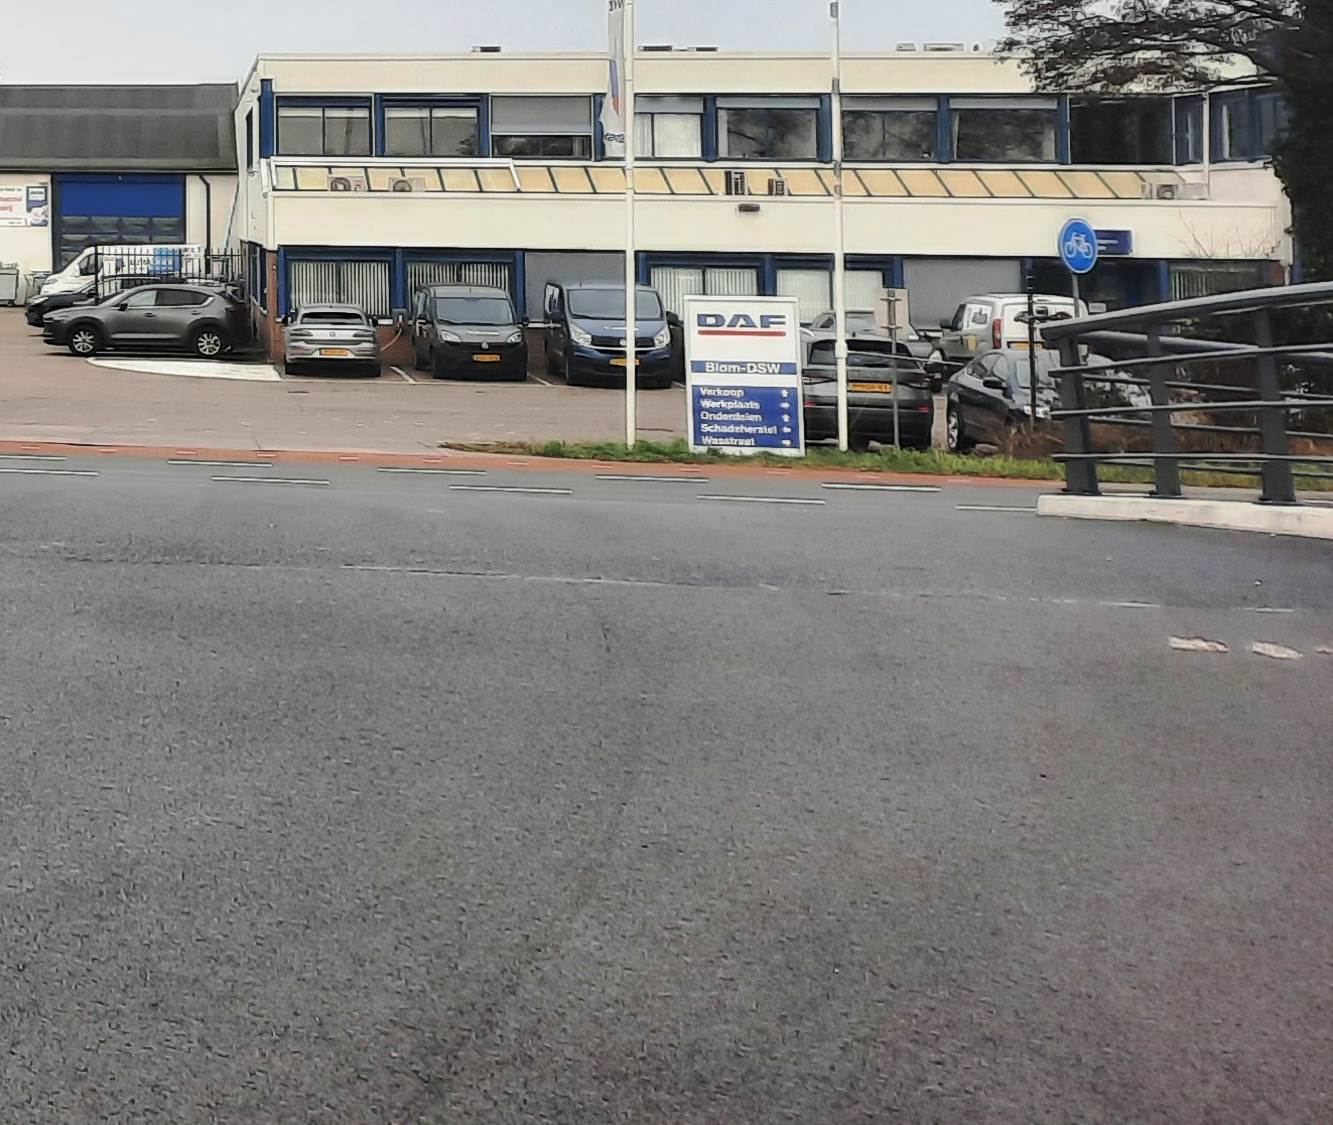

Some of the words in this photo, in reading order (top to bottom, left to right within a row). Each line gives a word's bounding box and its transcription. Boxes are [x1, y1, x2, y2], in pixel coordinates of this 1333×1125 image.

[697, 313, 786, 328] DAF
[705, 362, 781, 374] Blom-DSW
[700, 387, 744, 398] Verkoop
